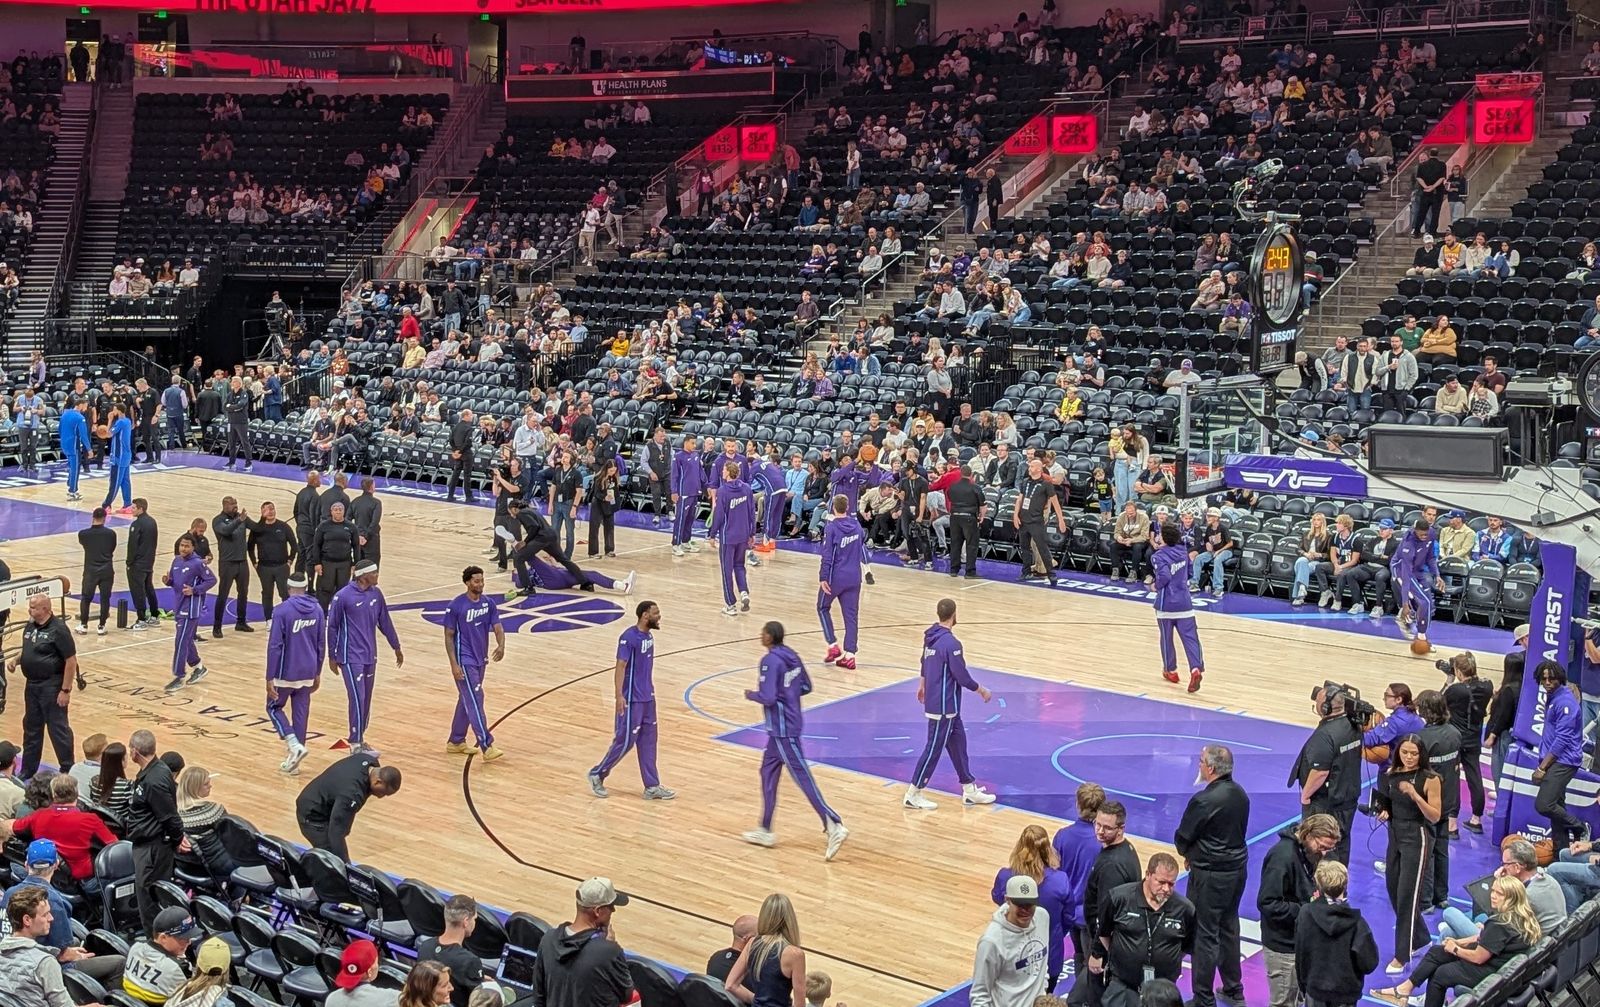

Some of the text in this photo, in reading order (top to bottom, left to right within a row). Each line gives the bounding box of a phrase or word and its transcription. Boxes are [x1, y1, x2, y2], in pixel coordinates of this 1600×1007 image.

[608, 80, 639, 89] HEALTH
[641, 79, 668, 88] PLANS
[1486, 107, 1521, 121] SEAT
[1483, 123, 1523, 136] GEEK
[1267, 247, 1289, 269] 2:43
[1271, 328, 1297, 343] TISSOT
[26, 586, 50, 597] Wilson
[465, 607, 489, 623] UTAH
[1544, 586, 1564, 647] FIRST
[292, 618, 317, 634] UTAH
[126, 956, 162, 986] JAZZ
